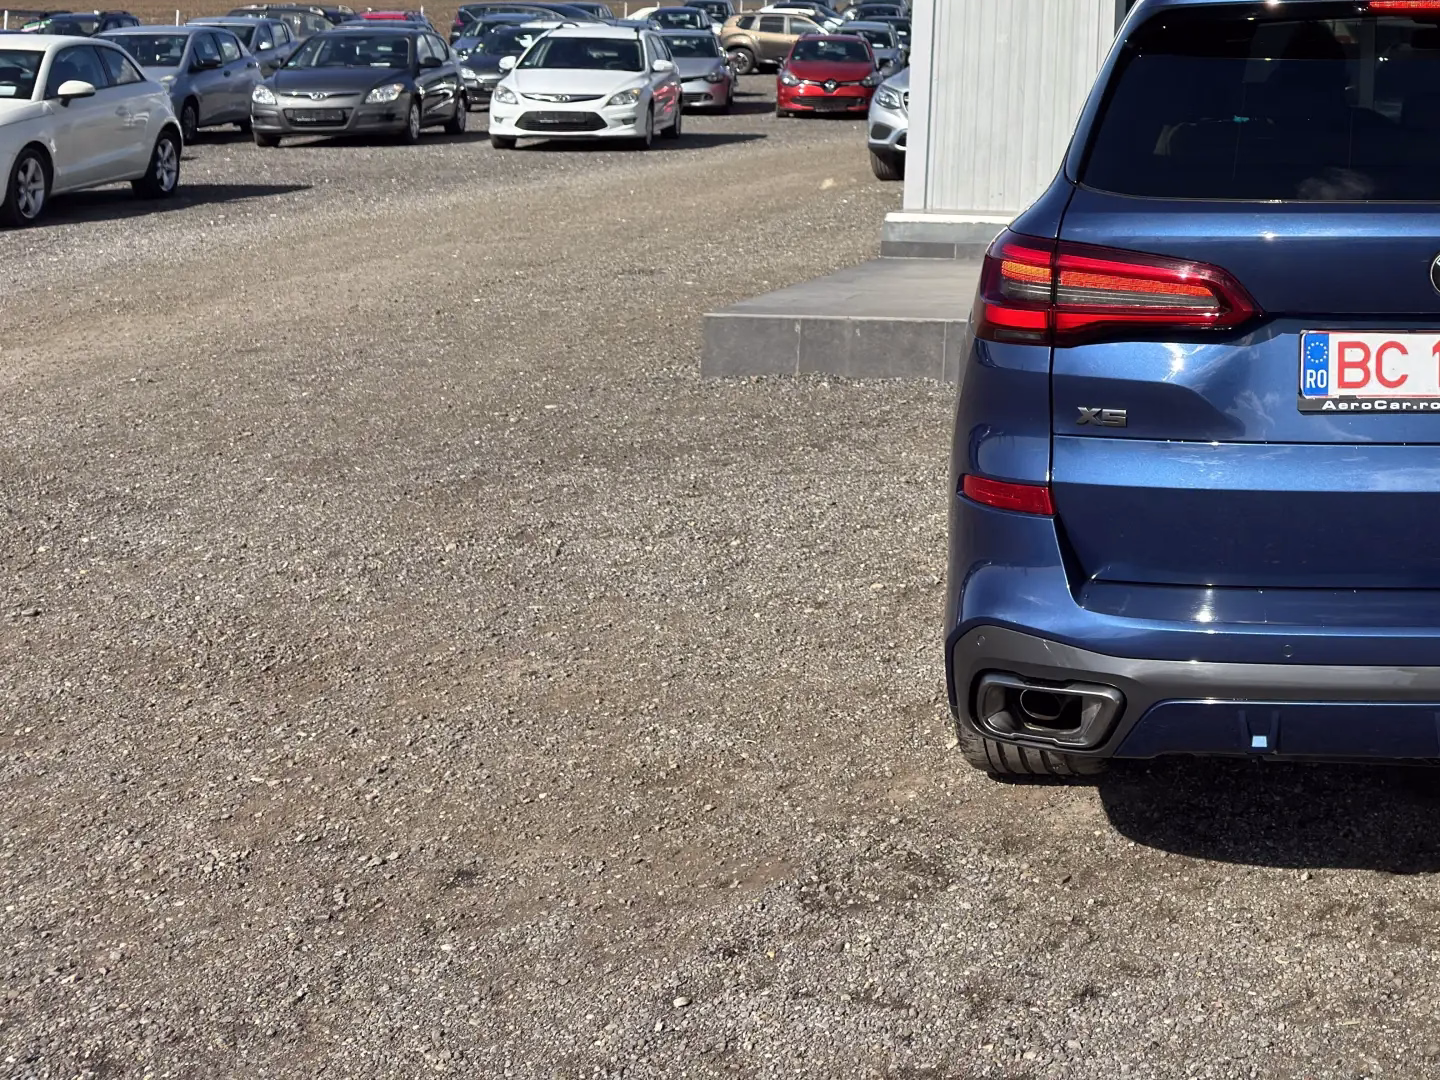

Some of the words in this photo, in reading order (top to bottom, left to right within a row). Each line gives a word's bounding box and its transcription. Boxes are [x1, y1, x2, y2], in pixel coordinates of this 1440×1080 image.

[1337, 340, 1409, 388] BC
[1306, 369, 1327, 388] RO
[1076, 406, 1127, 427] X5
